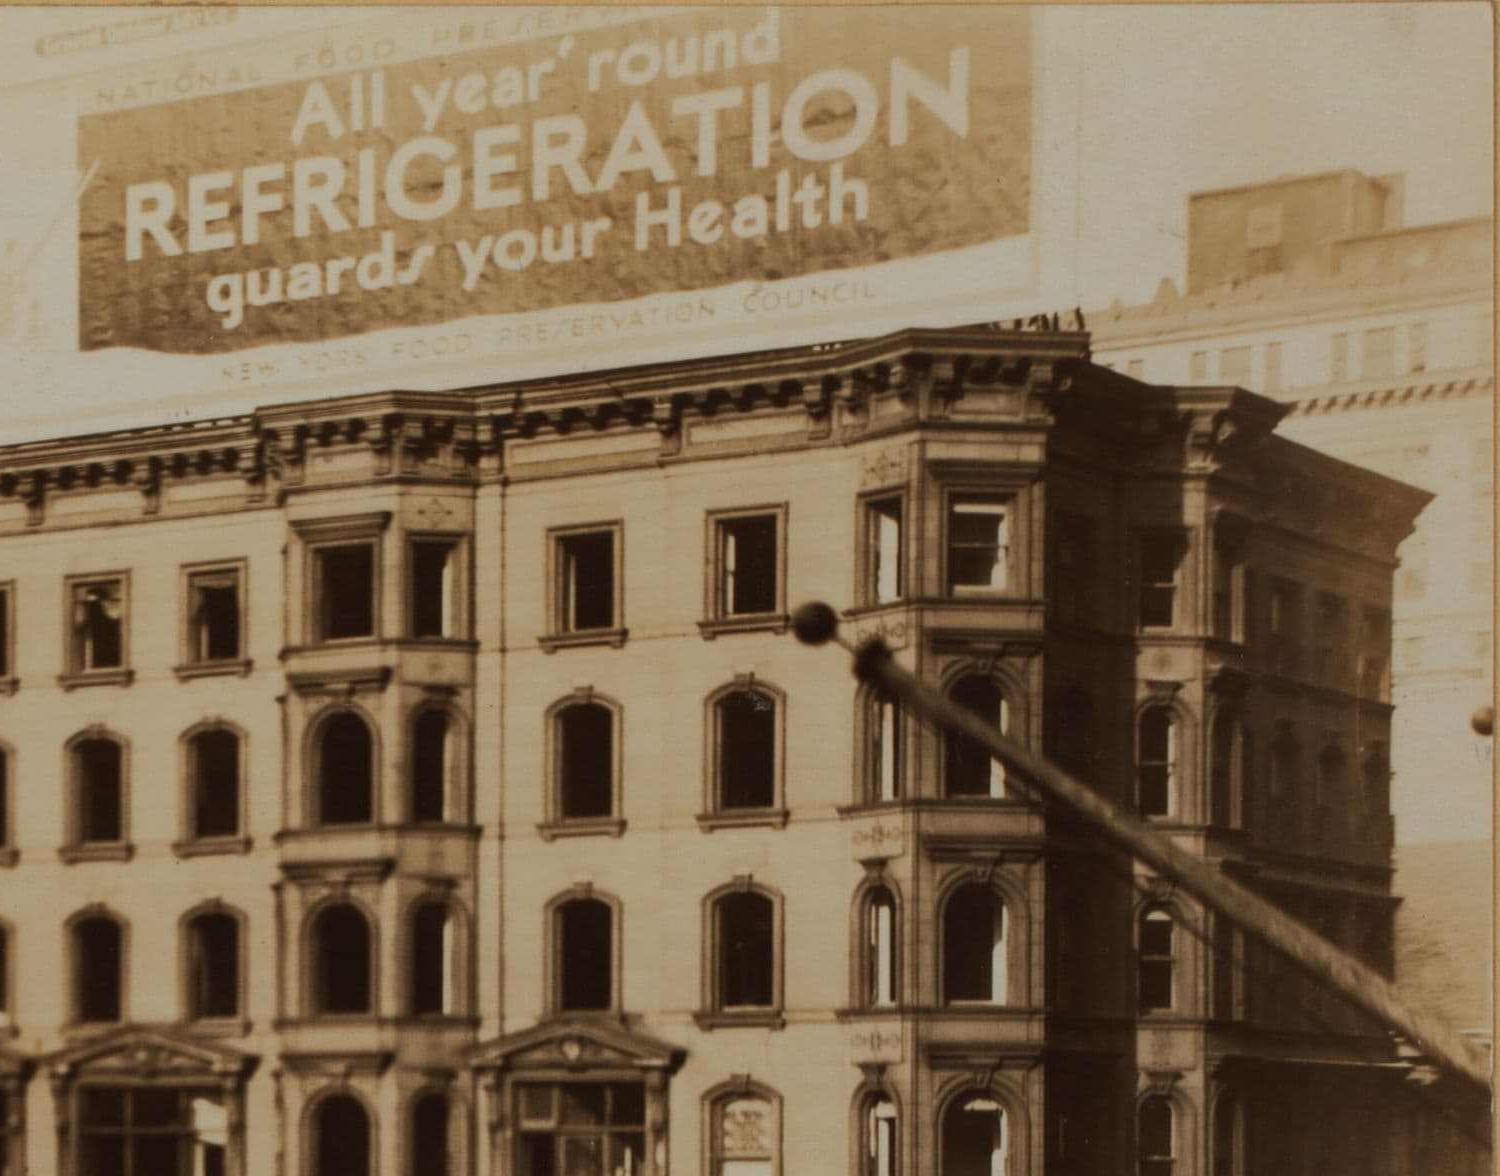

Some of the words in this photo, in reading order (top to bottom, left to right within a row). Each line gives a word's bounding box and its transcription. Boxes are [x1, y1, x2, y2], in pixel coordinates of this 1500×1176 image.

[94, 63, 262, 107] NATIONAL
[290, 70, 386, 144] All
[589, 6, 781, 92] round
[123, 45, 970, 261] REFRIGERATION
[205, 229, 435, 330] guards
[457, 213, 613, 292] your
[634, 163, 870, 251] Health
[391, 333, 473, 360] FOOD
[499, 297, 717, 346] PRESERVATION
[742, 279, 877, 314] COUNCIL
